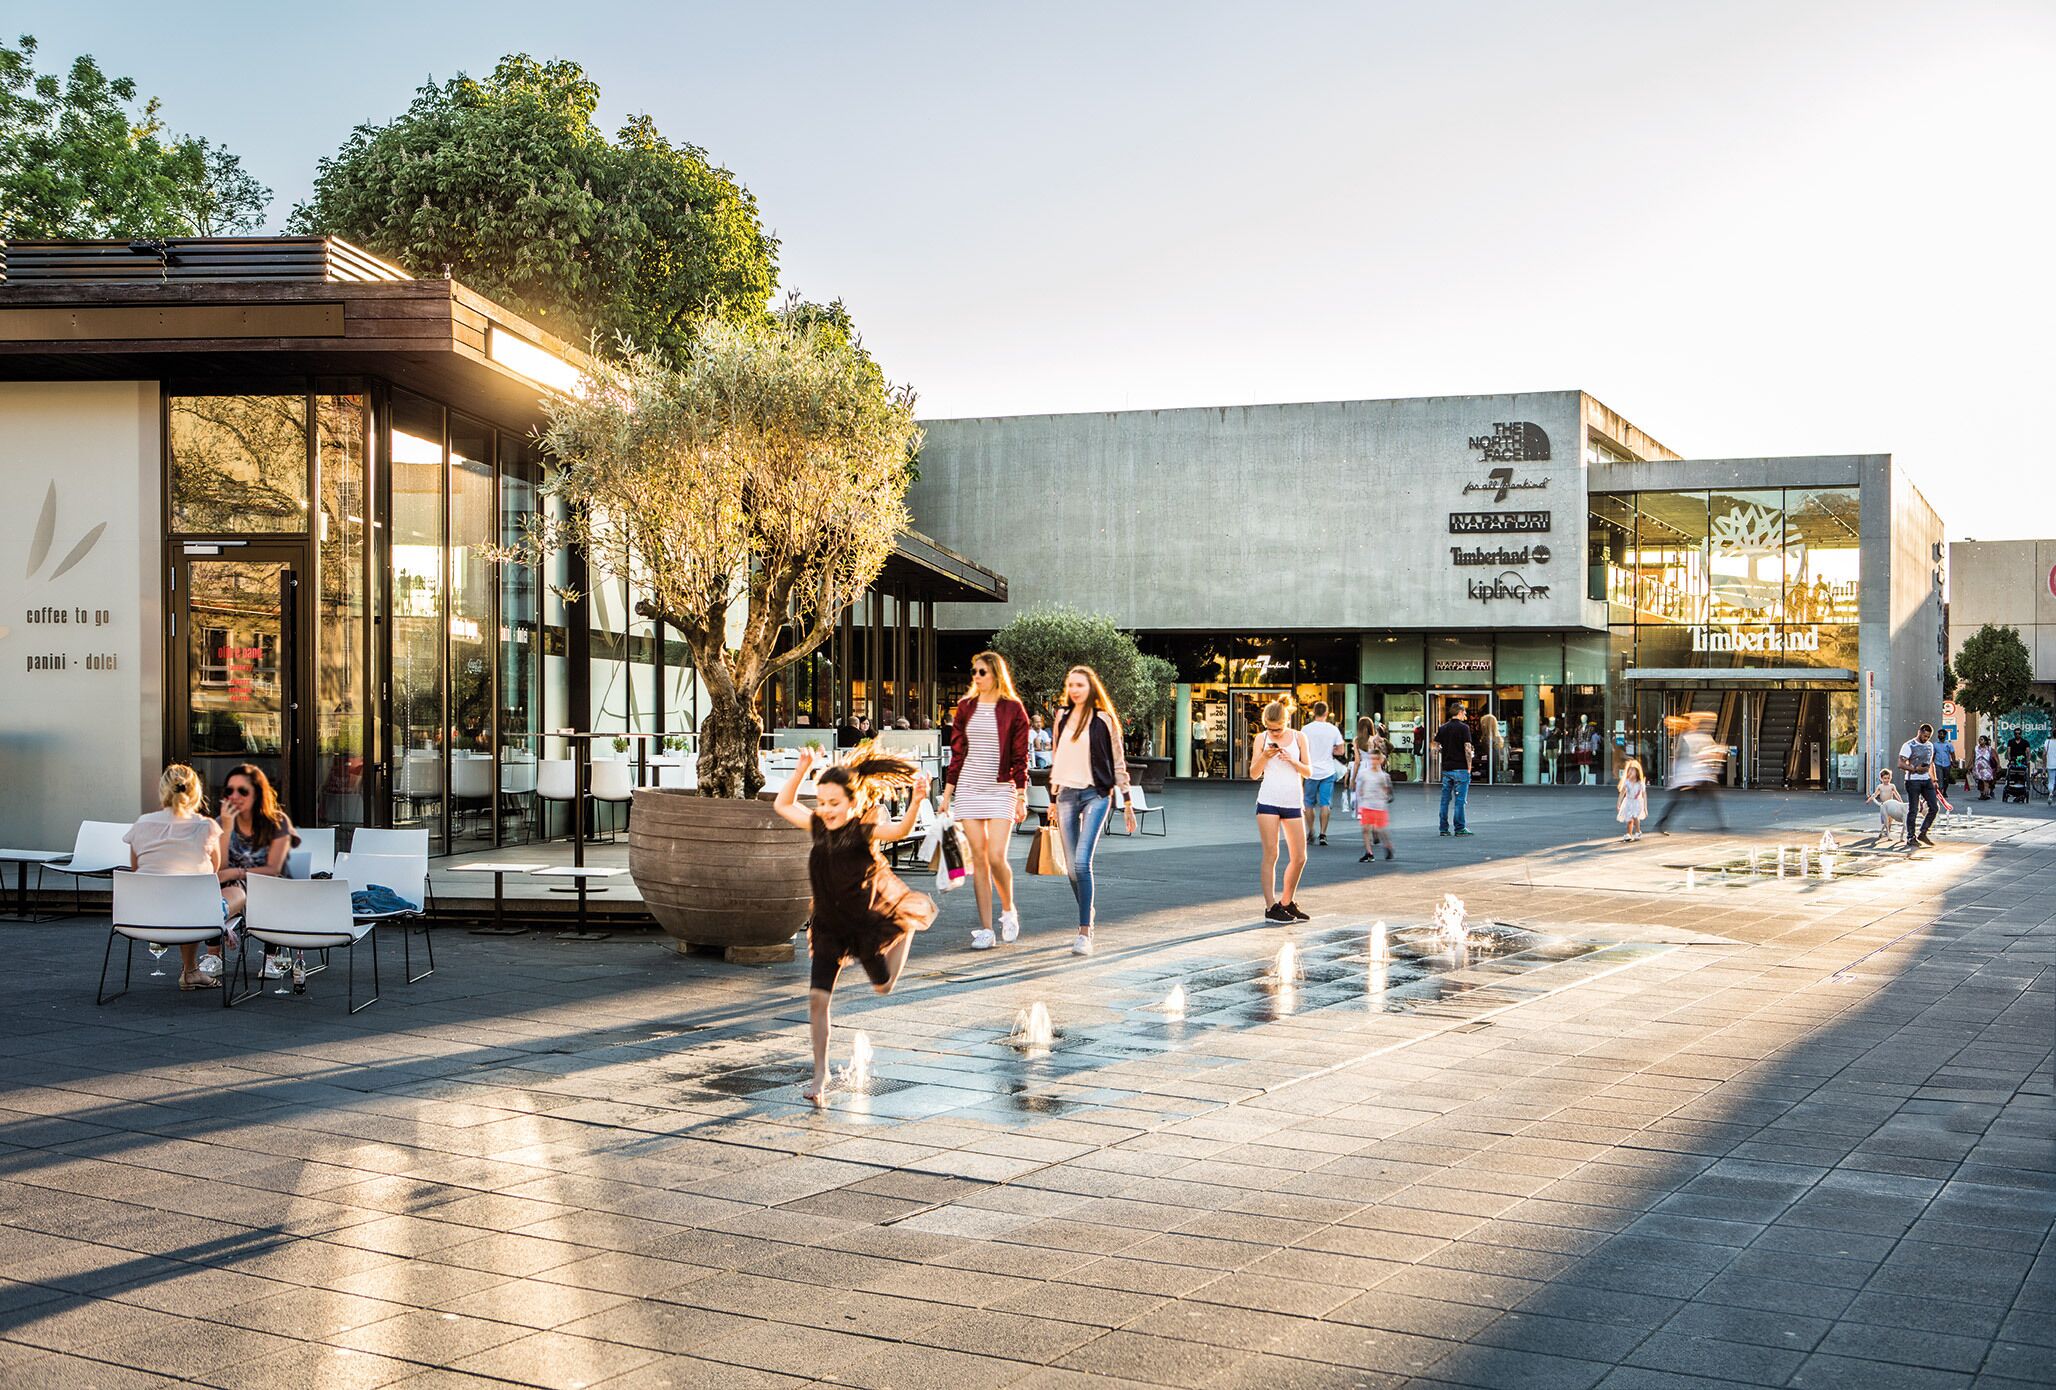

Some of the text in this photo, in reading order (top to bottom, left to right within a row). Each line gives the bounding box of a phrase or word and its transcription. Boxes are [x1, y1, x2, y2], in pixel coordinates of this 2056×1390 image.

[1493, 422, 1524, 435] THE
[1469, 435, 1524, 449] NORTH
[1483, 448, 1524, 462] FACE
[1489, 468, 1514, 503] 7
[1451, 513, 1549, 531] NAPAPIJRI
[1450, 545, 1529, 565] Timberland
[26, 607, 110, 627] coffee to go
[1687, 625, 1818, 652] Timberland
[26, 653, 118, 673] panini dolci
